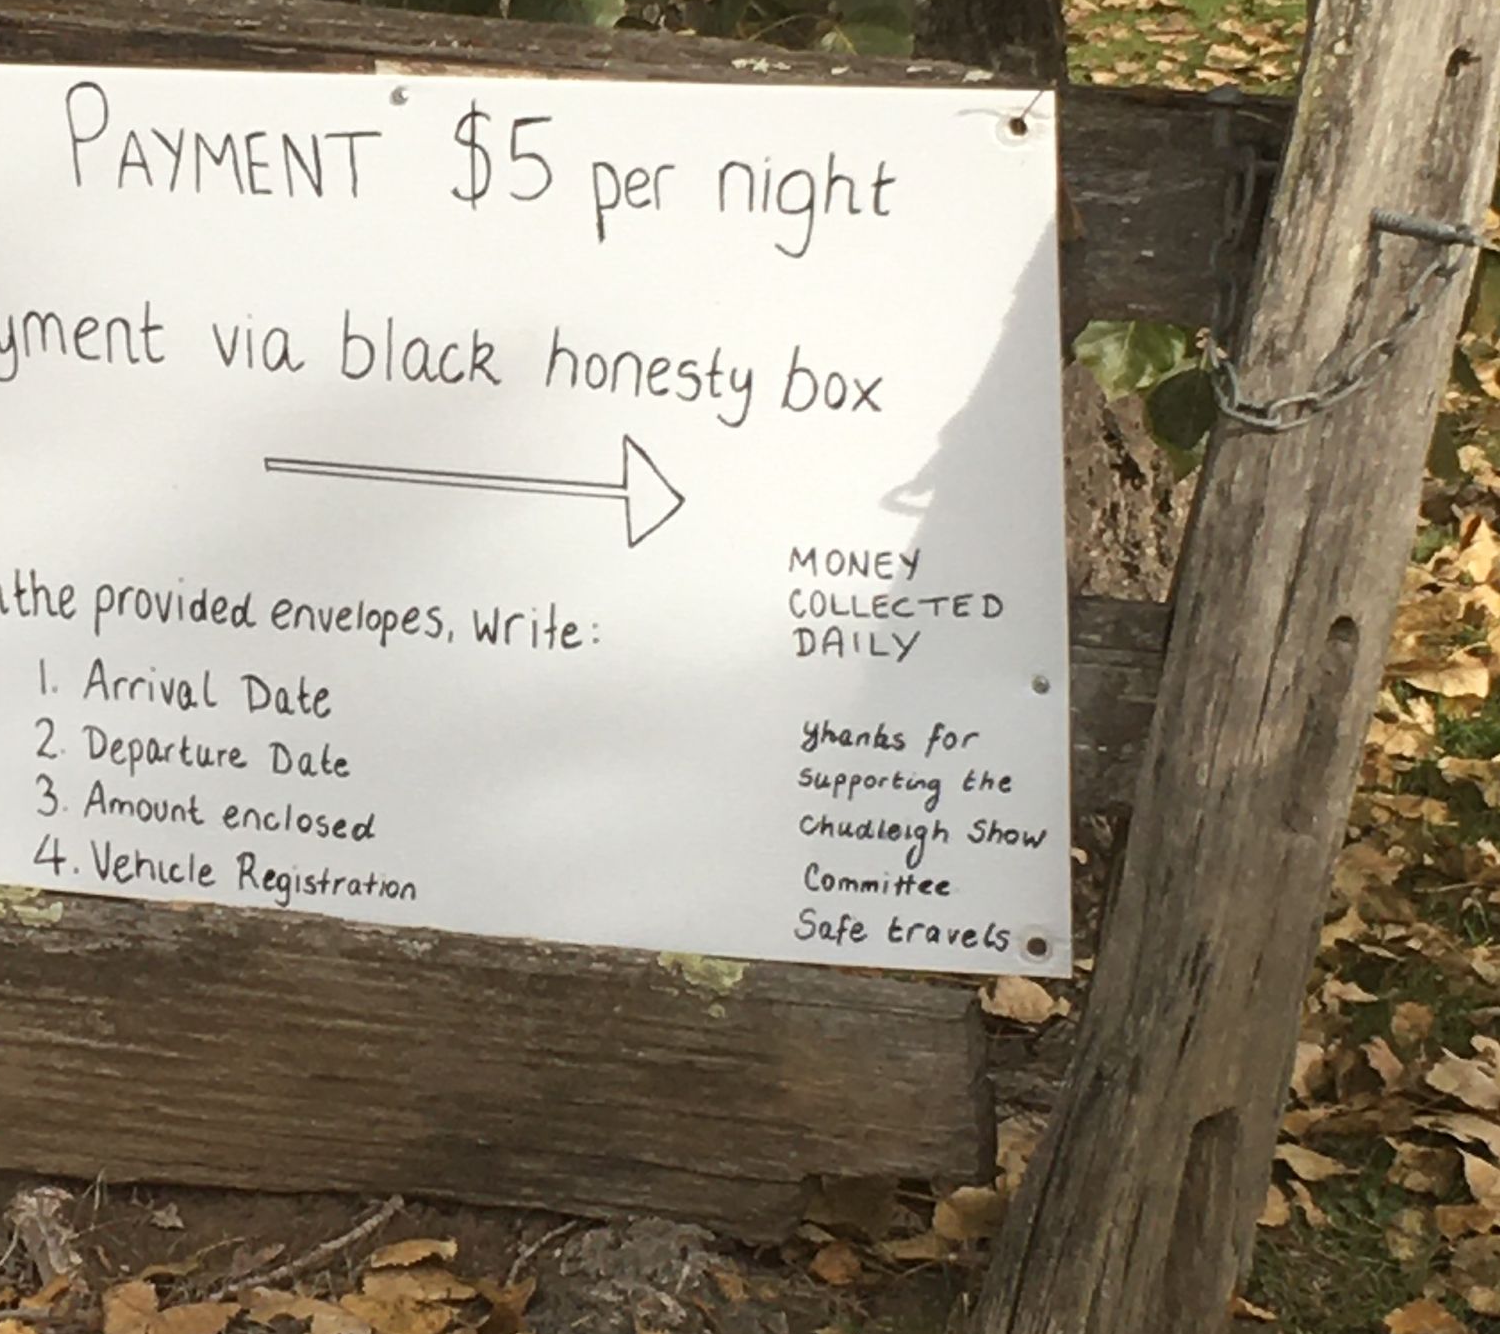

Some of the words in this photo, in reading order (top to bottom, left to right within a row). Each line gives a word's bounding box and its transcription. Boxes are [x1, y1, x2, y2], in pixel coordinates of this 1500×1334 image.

[450, 99, 554, 209] $5
[591, 161, 676, 244] per
[718, 152, 897, 258] night
[212, 319, 306, 373] via
[338, 310, 502, 387] black
[545, 325, 755, 427] honesty
[780, 345, 884, 413] box
[789, 547, 921, 581] MONEY
[93, 576, 257, 637] provided
[270, 597, 454, 649] envelopes,
[788, 588, 1004, 619] COLLECTED
[792, 626, 921, 663] DAILY
[82, 657, 218, 709] Arrival
[240, 673, 332, 719] Date
[35, 716, 67, 760] 2.
[82, 724, 248, 777] Departure
[270, 740, 351, 779] Date
[924, 722, 980, 757] for
[962, 769, 1013, 794] the
[35, 772, 68, 817] 3.
[82, 779, 205, 827] Amount
[222, 804, 376, 842] enclosed
[967, 818, 1048, 849] Show
[33, 833, 80, 878] 4.
[90, 838, 217, 888] Vehicle
[236, 850, 417, 907] Registration
[804, 862, 951, 897] Committee
[794, 907, 868, 945] Safe
[887, 916, 1011, 953] travels
